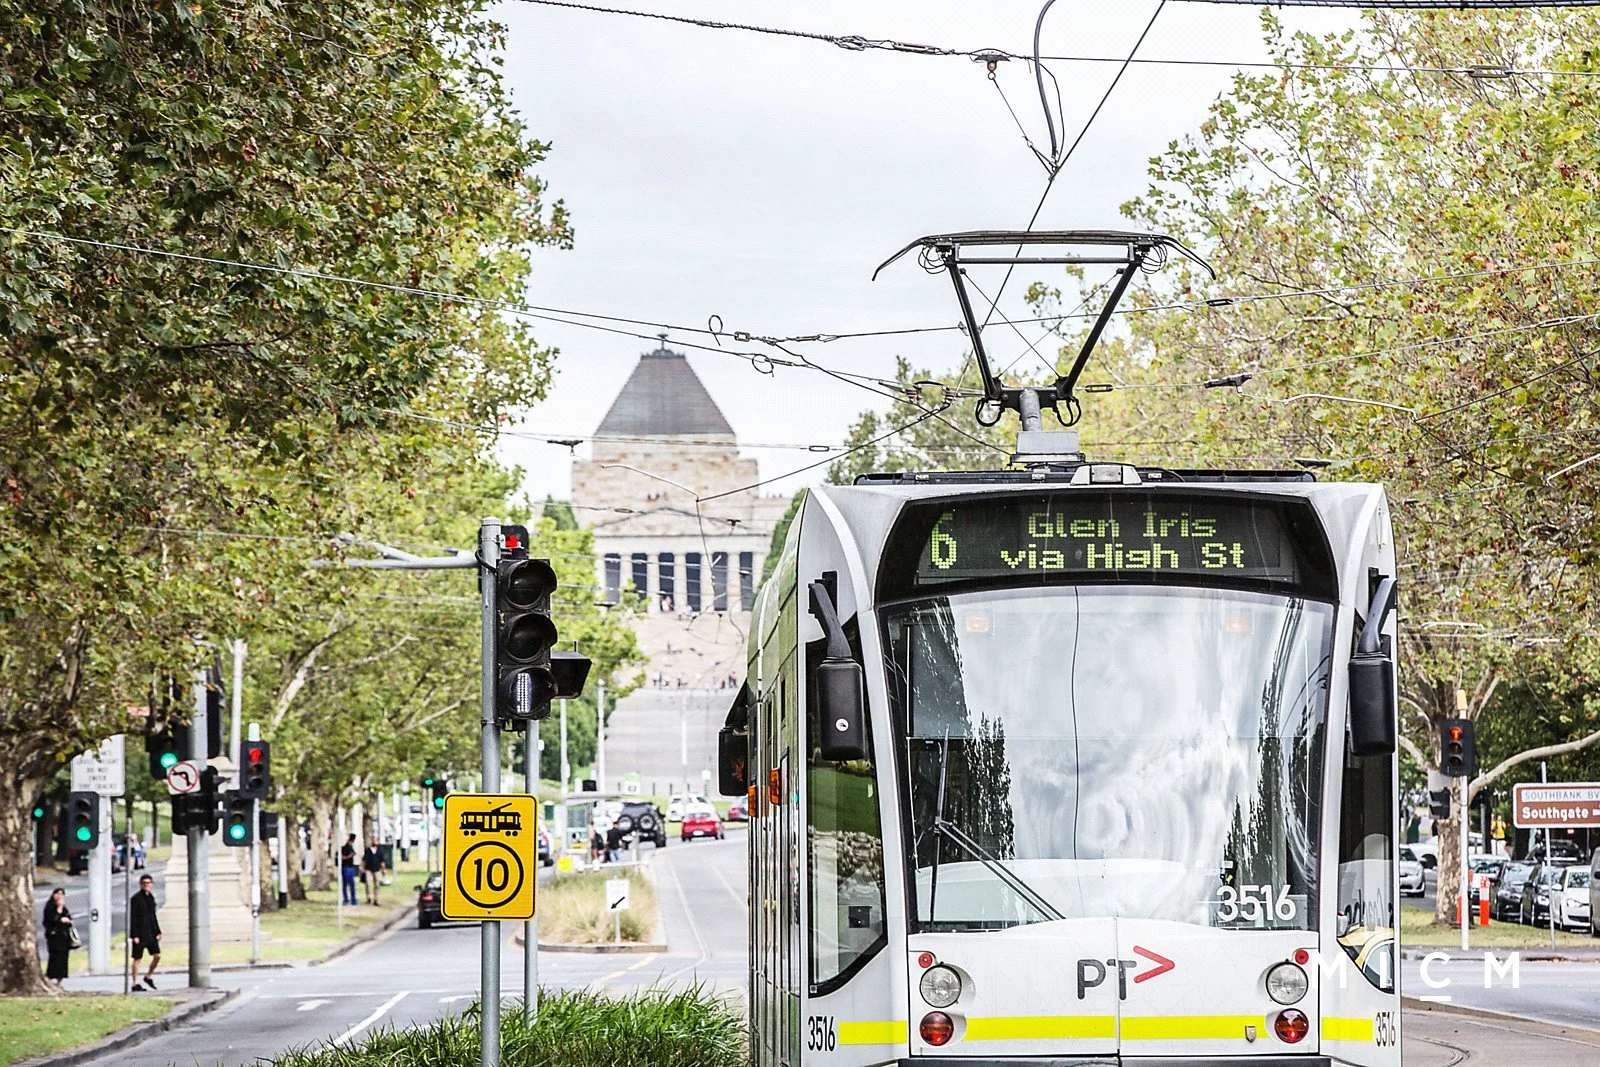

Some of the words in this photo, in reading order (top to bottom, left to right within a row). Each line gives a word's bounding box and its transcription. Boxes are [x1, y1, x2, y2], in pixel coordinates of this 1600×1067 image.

[931, 513, 957, 569] 6
[1028, 512, 1120, 538] Glen
[1142, 512, 1217, 538] Iris
[1000, 543, 1065, 569] via
[1087, 543, 1179, 569] High
[1201, 543, 1245, 569] St
[1525, 790, 1582, 800] SOUTHBANK
[1522, 806, 1589, 822] Southgate
[474, 858, 509, 892] 10
[1216, 884, 1296, 922] 3516
[807, 1016, 836, 1052] 3516
[1375, 1011, 1396, 1047] 3516
